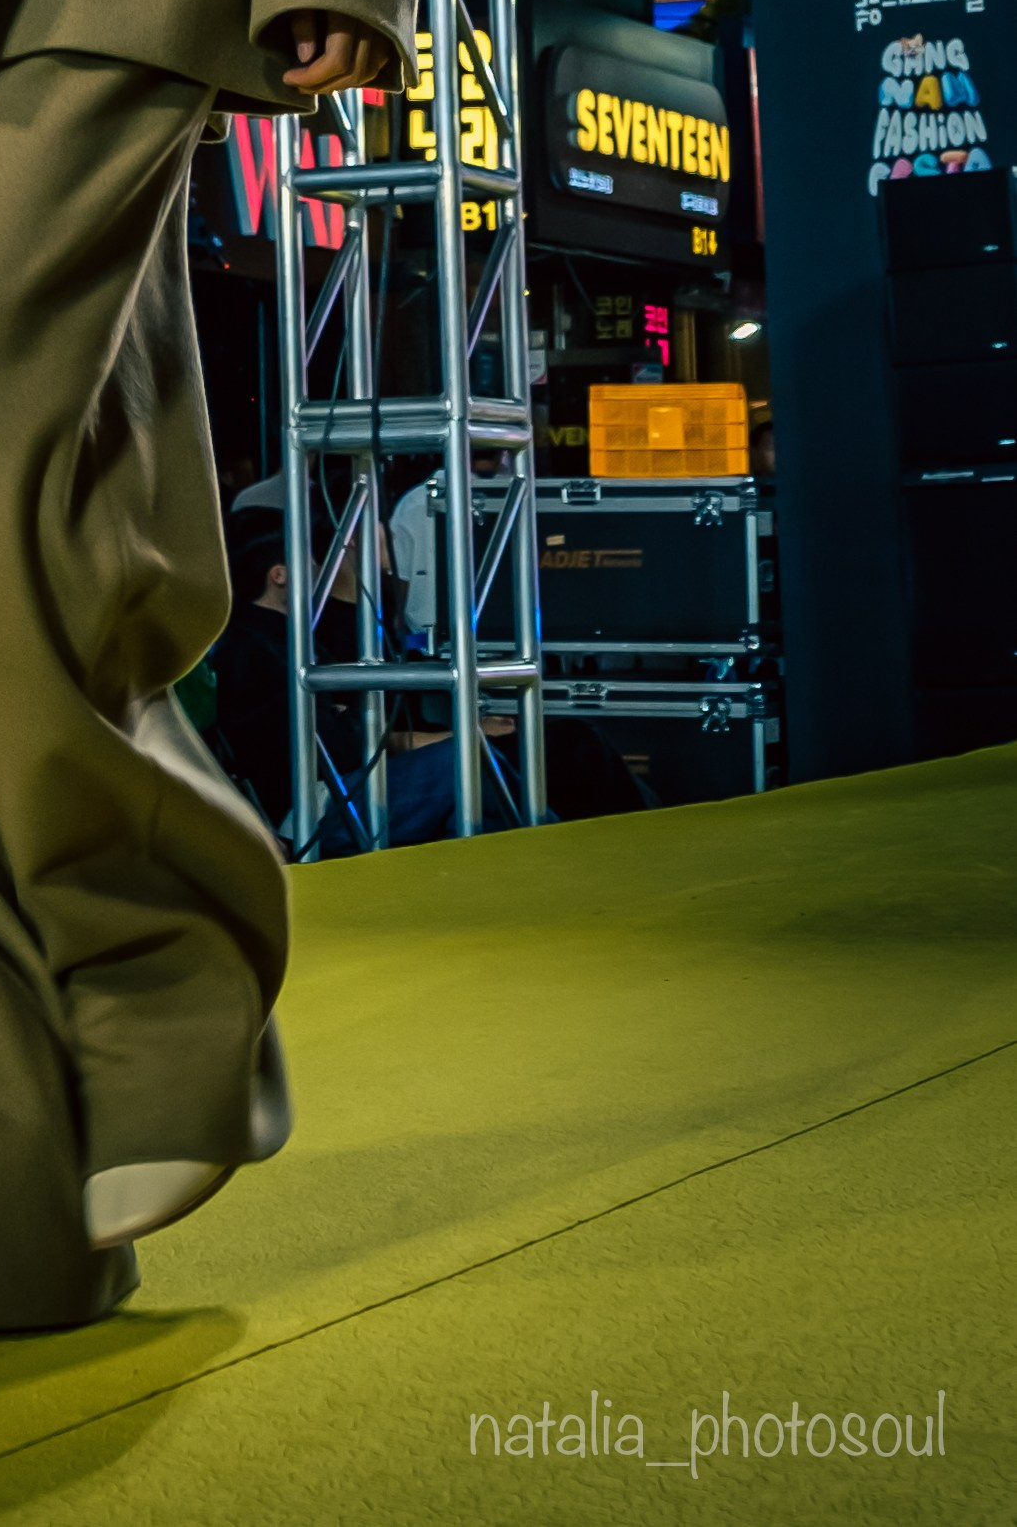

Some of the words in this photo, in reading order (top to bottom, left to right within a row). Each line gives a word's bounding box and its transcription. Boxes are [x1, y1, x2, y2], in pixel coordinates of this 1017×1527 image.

[882, 36, 970, 77] GANG
[879, 71, 980, 110] NAM
[576, 88, 731, 183] SEVENTEEN
[460, 201, 497, 231] B1
